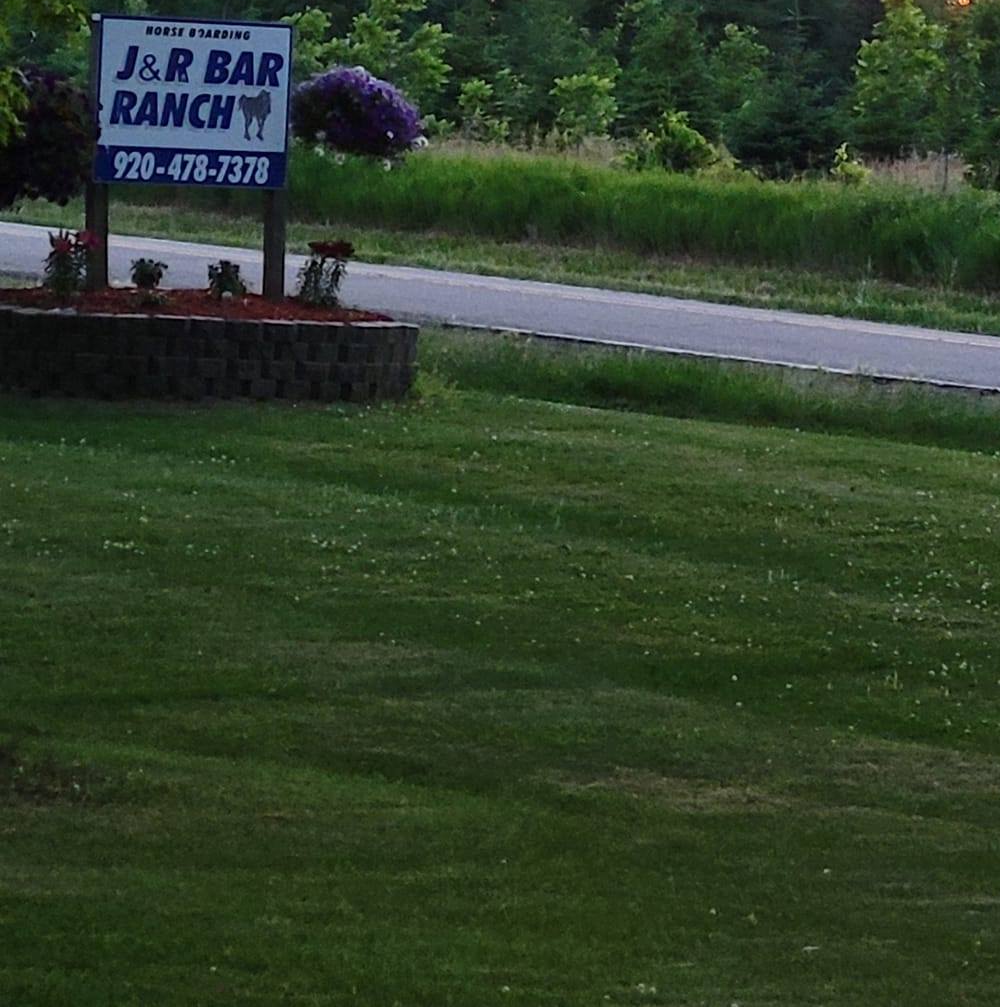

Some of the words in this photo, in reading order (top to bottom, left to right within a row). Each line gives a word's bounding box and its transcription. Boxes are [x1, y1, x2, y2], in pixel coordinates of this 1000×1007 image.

[145, 25, 185, 37] HORSE
[116, 45, 194, 83] J&R
[204, 49, 284, 87] BAR
[109, 90, 236, 130] RANCH
[113, 151, 270, 185] 920-478-7378
